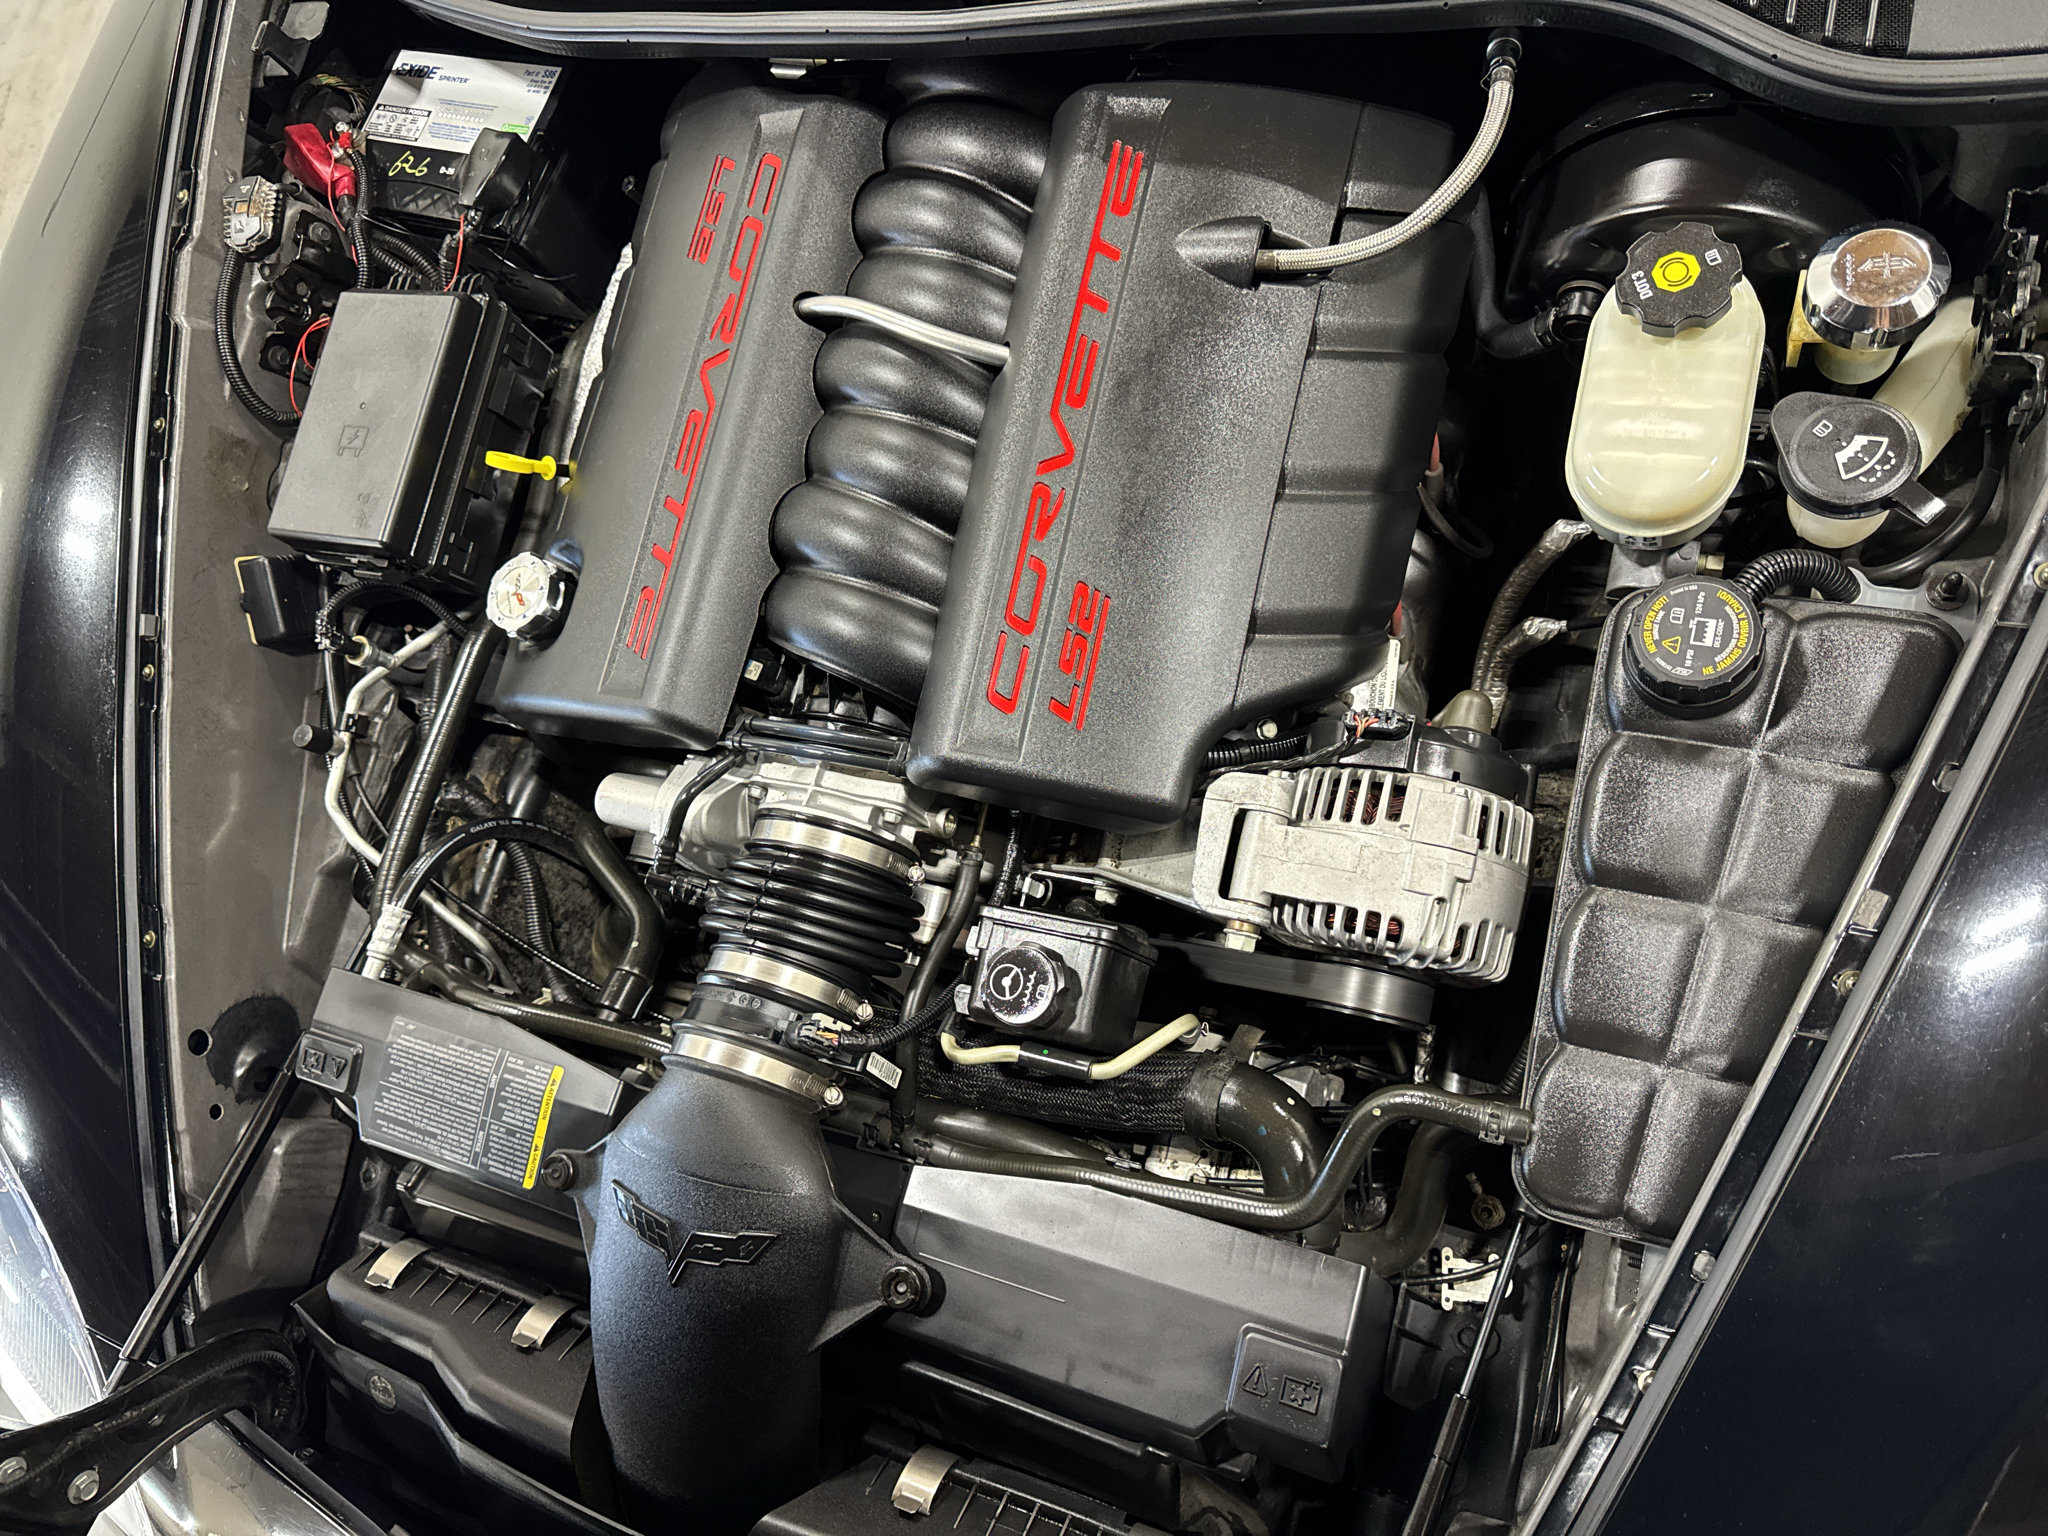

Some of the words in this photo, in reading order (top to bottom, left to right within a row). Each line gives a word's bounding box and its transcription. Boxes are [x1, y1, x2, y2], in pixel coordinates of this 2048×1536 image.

[395, 62, 440, 80] EXIDE
[438, 74, 468, 84] SPRINTER
[389, 150, 431, 177] 626
[687, 154, 736, 264] LS2
[626, 152, 782, 660] CORVETTE
[987, 141, 1143, 715] CORVETTE
[1652, 595, 1669, 614] HOT!
[1716, 589, 1743, 613] CHAUD!
[1643, 610, 1657, 630] OPEN
[1643, 630, 1658, 654] NEVER
[1738, 620, 1750, 648] OUVRIR
[1049, 581, 1110, 730] LS2
[1685, 649, 1695, 659] PSI
[1716, 648, 1742, 672] JAMAIS
[1702, 666, 1715, 676] NE
[1369, 684, 1378, 707] BOUCHON
[1377, 690, 1386, 711] LEMENT
[469, 819, 497, 834] GALAXY
[541, 1086, 558, 1121] ATTENTION
[528, 1153, 541, 1180] CAUTION
